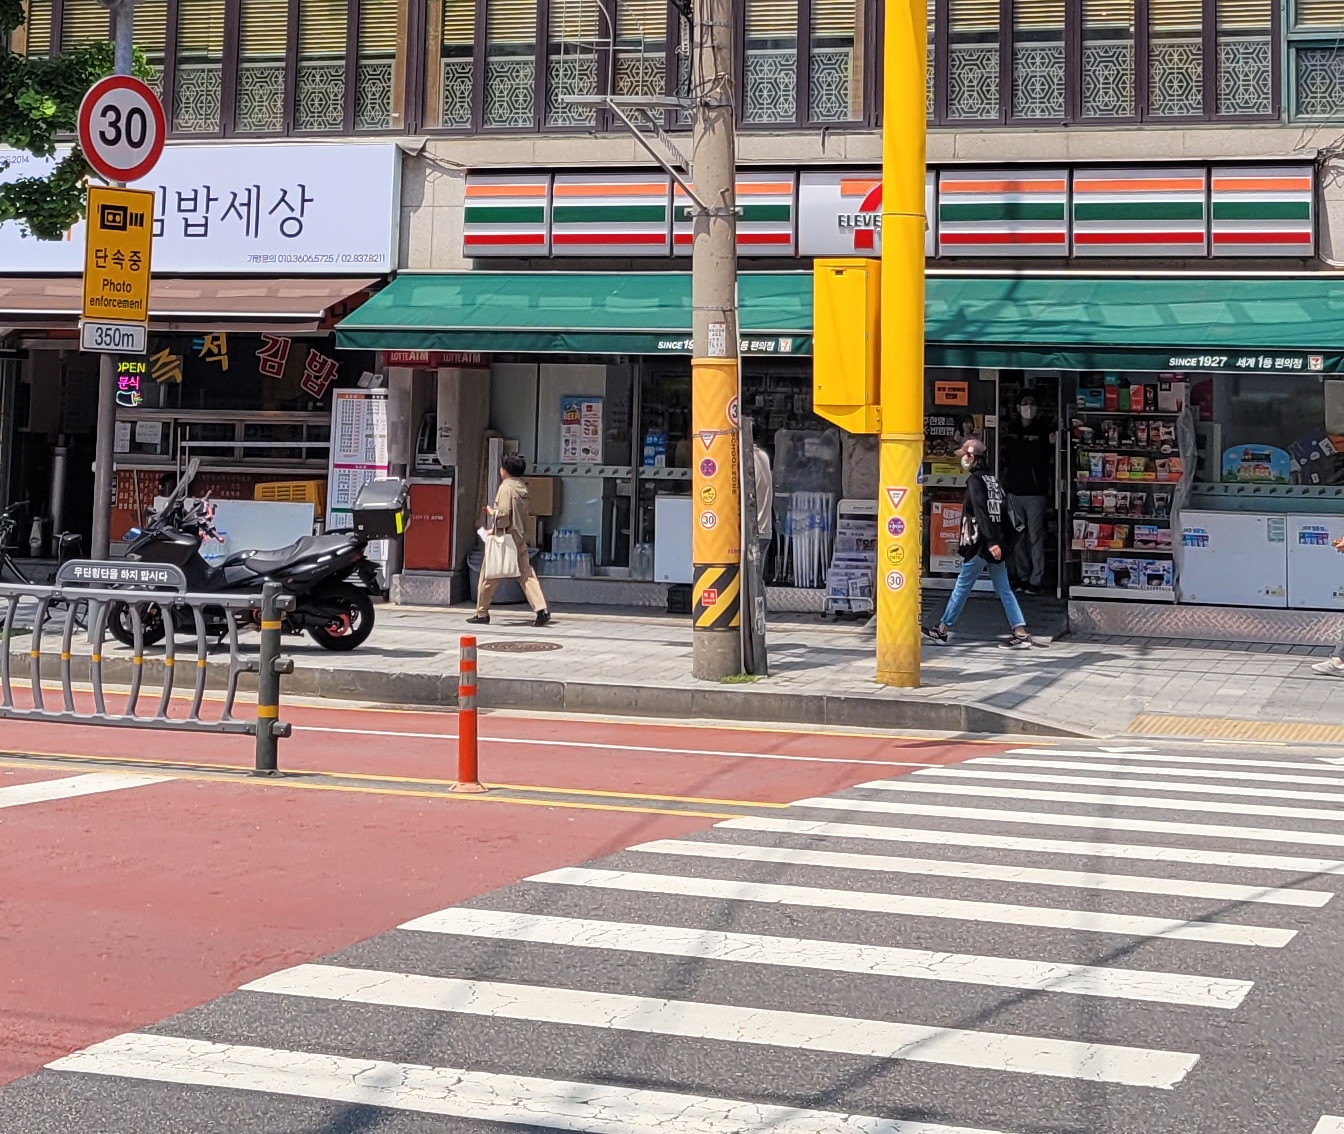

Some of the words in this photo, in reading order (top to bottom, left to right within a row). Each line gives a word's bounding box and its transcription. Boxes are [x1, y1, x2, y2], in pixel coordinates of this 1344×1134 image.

[98, 104, 147, 148] 30
[838, 214, 882, 229] ELEVE
[95, 247, 143, 272] 단속중
[102, 277, 132, 294] Photo
[89, 294, 143, 310] enforcement
[94, 327, 135, 348] 350m
[256, 333, 338, 399] 김밥
[1236, 357, 1255, 369] 세계
[1274, 357, 1303, 369] 편의점
[702, 515, 715, 525] 30
[73, 567, 119, 580] 무단횡단을
[120, 569, 138, 581] 하지
[889, 575, 902, 586] 30
